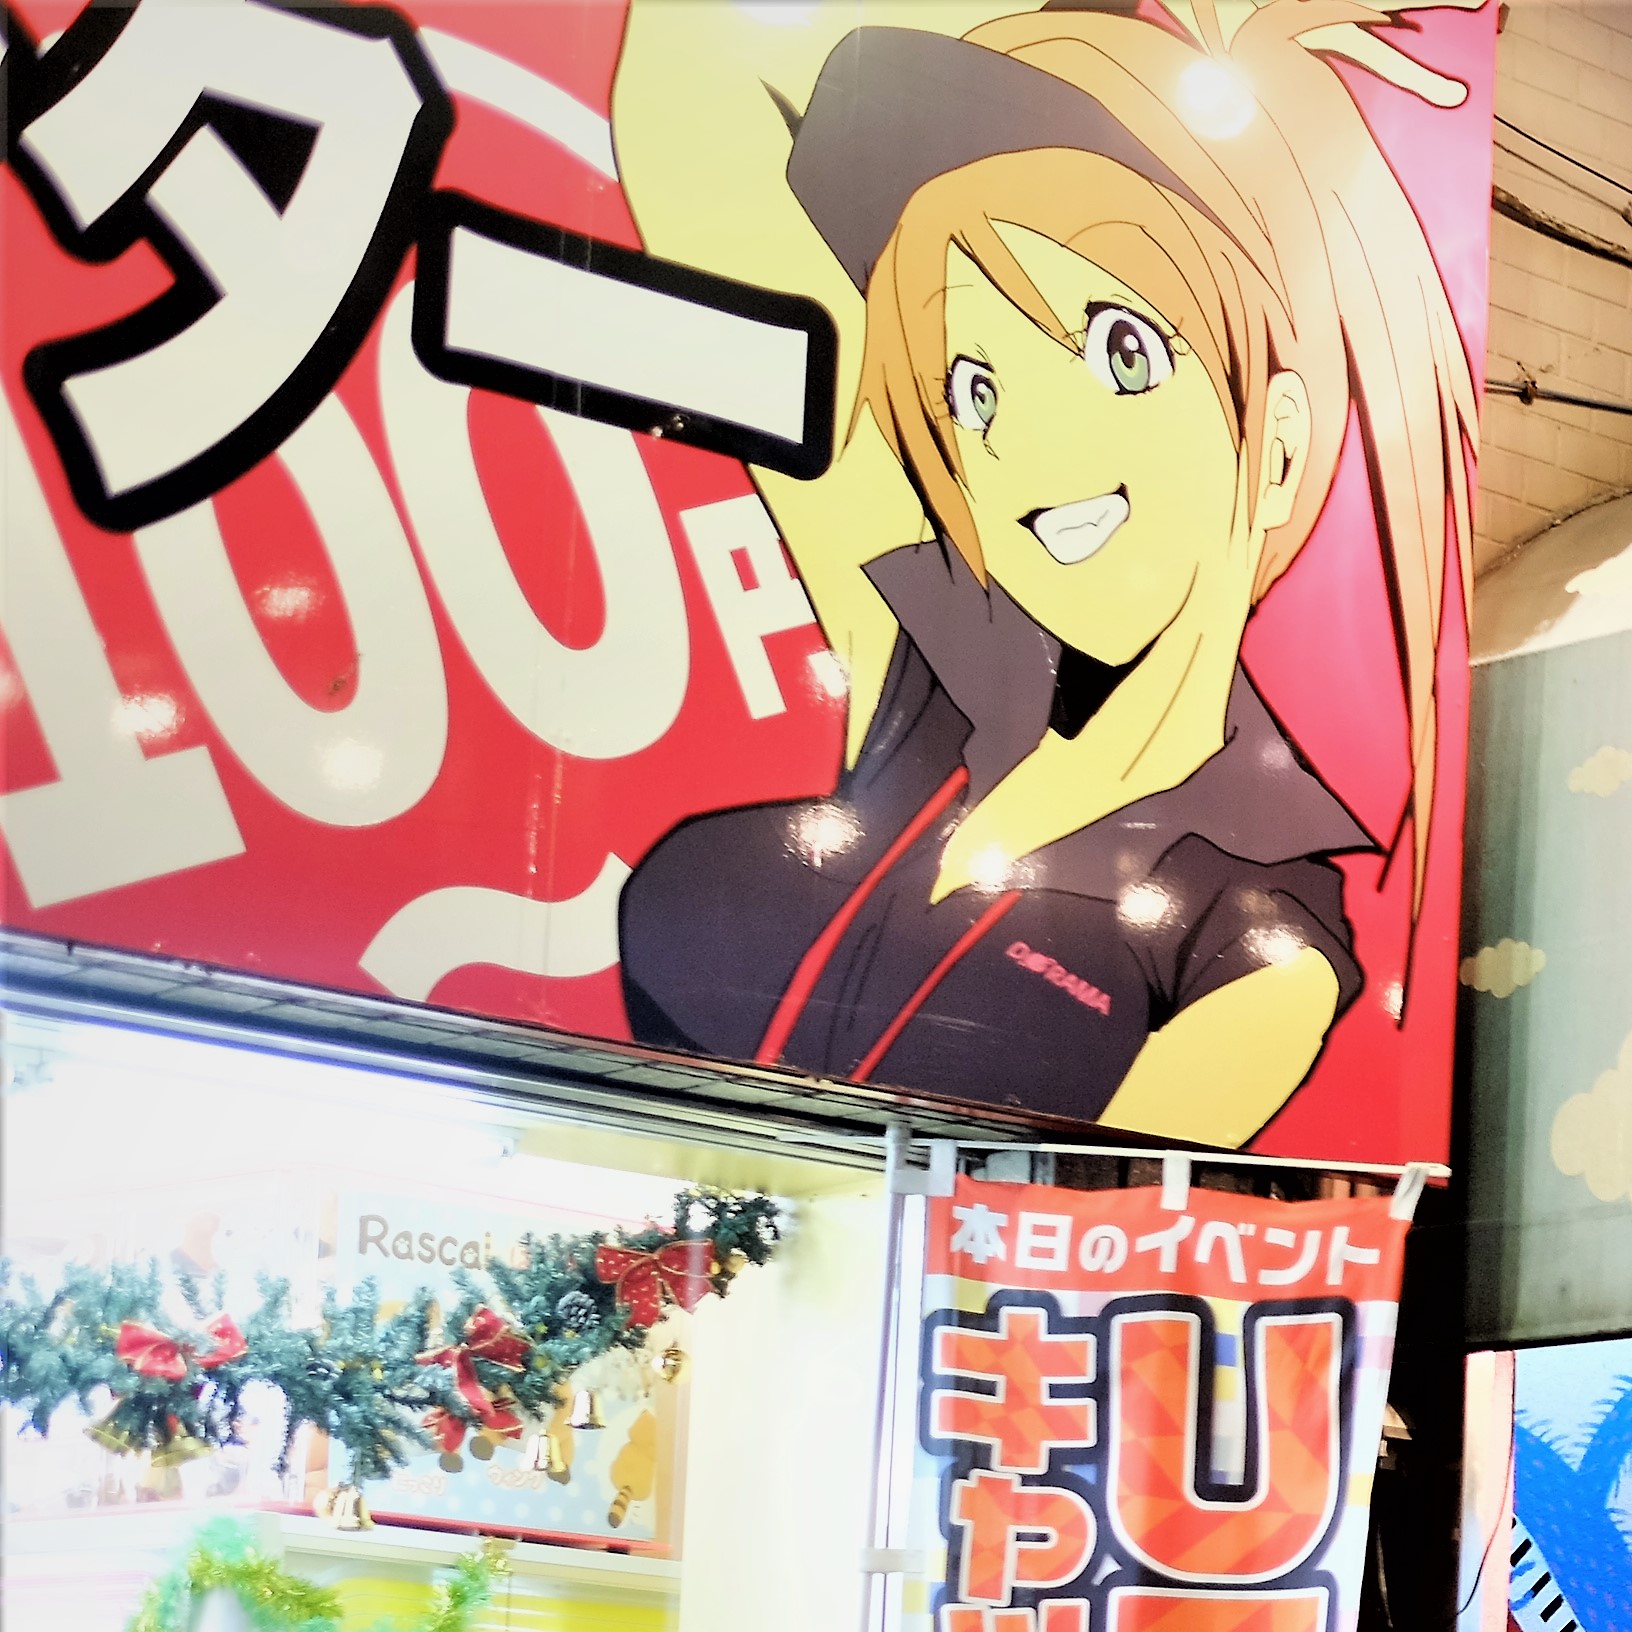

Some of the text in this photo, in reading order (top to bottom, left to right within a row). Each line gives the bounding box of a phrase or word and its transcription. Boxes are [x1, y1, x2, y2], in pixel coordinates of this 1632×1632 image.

[950, 1202, 1381, 1286] 本日のイベント
